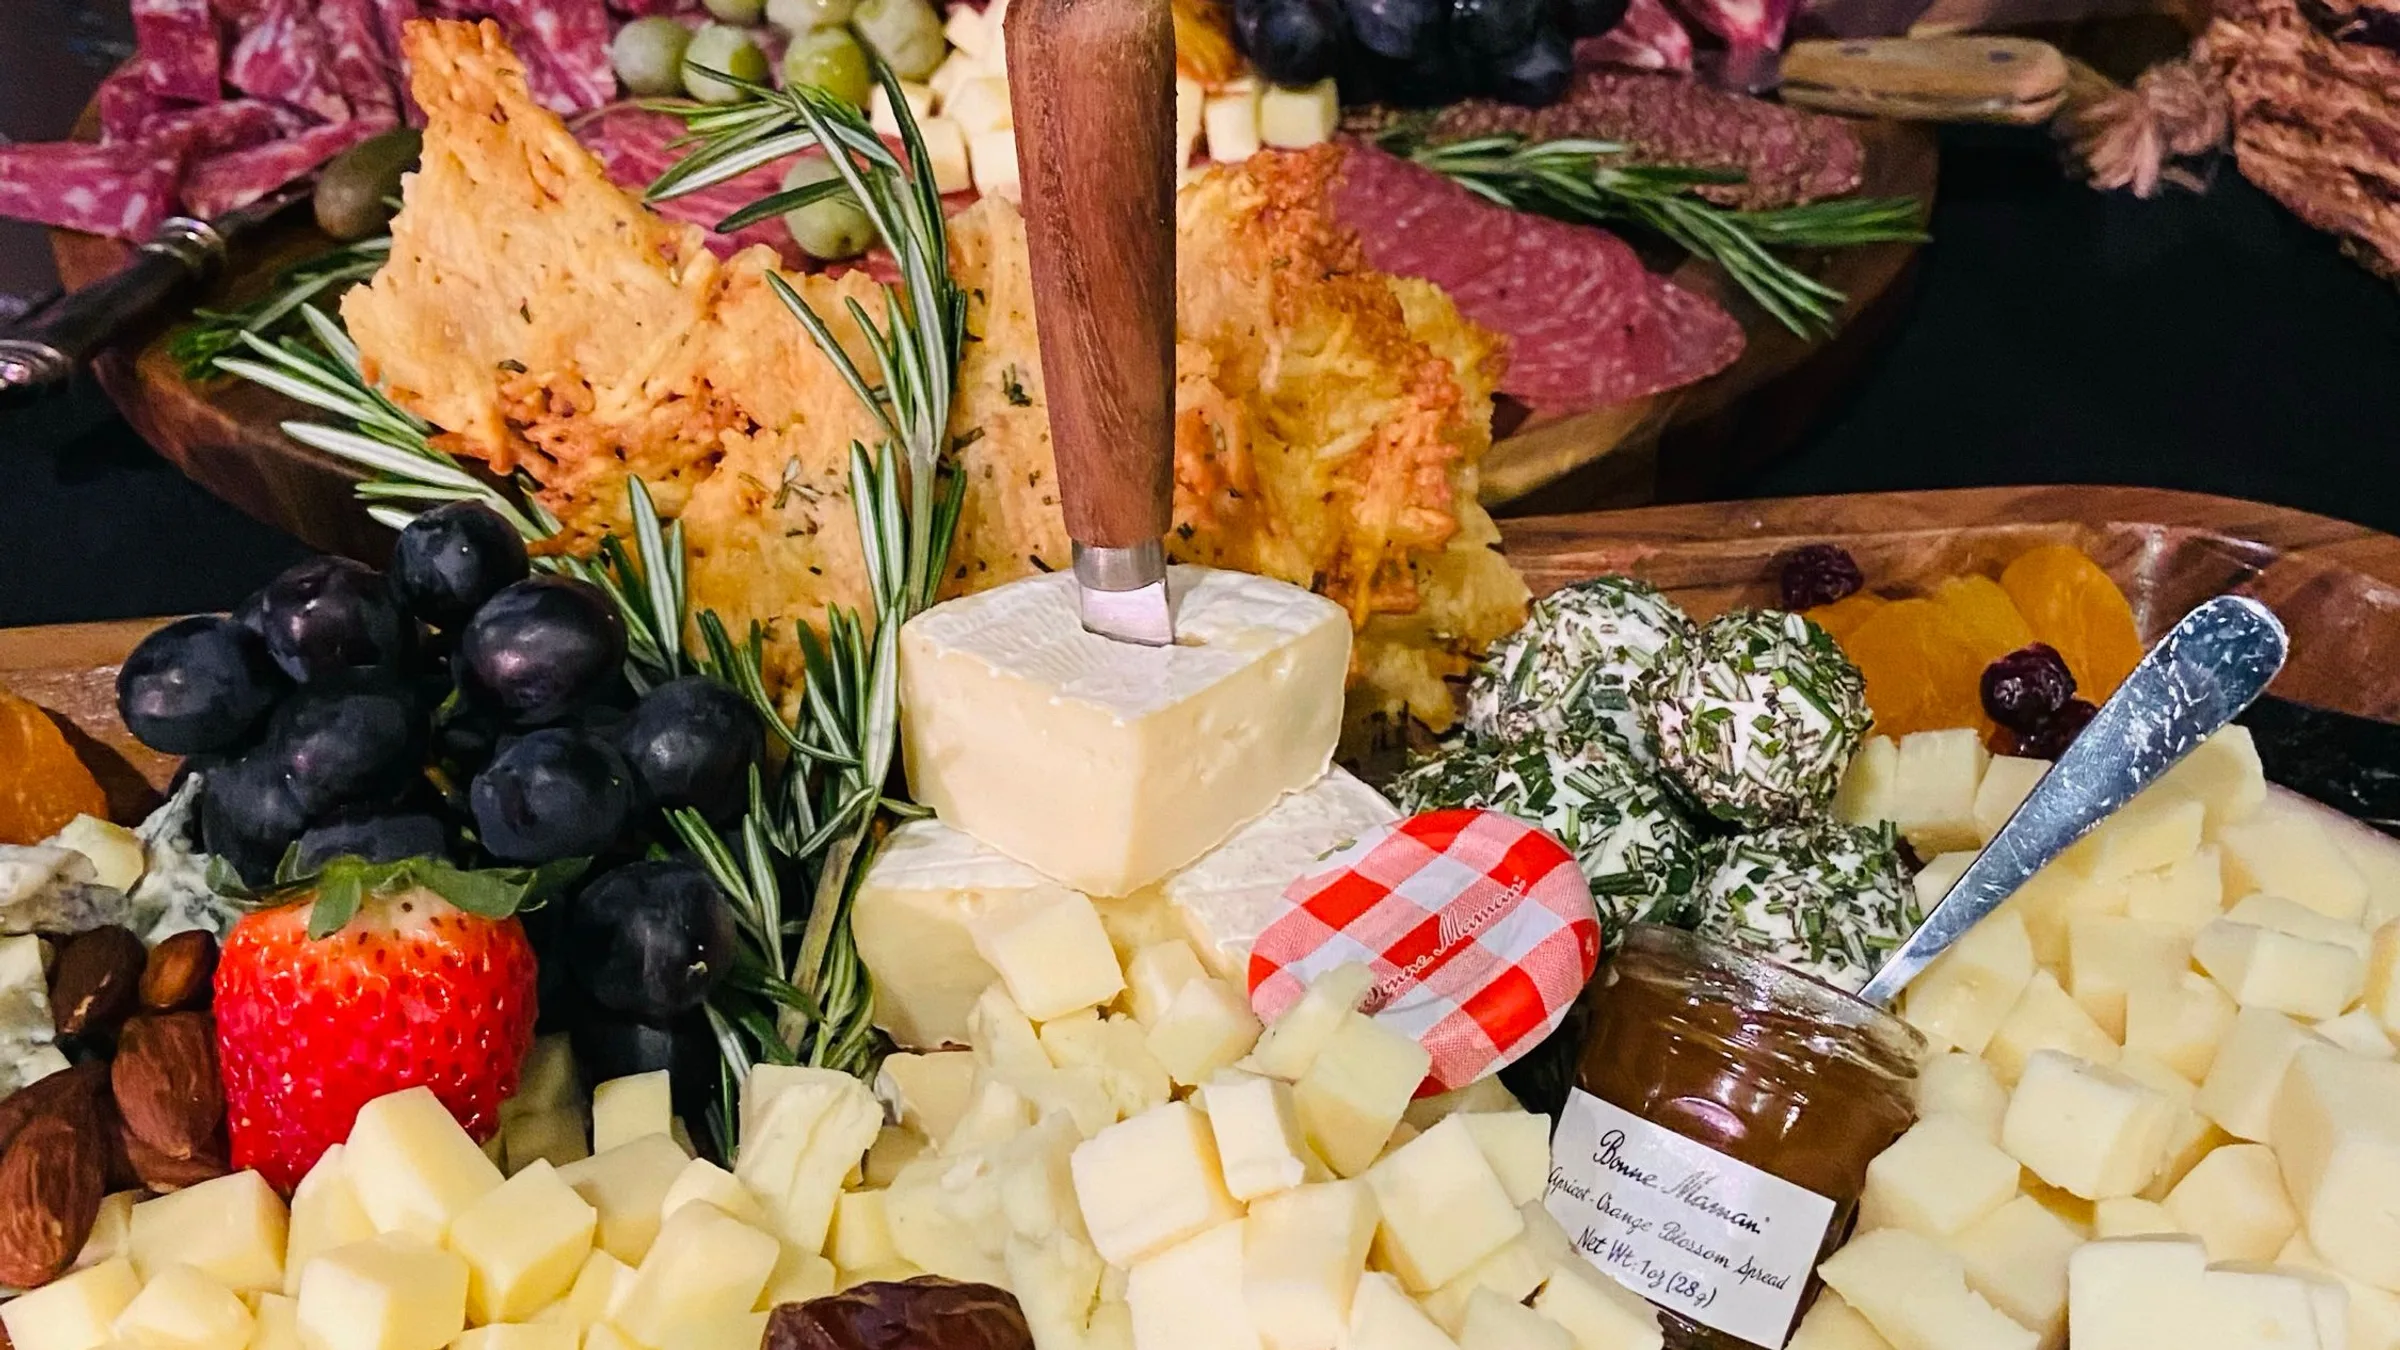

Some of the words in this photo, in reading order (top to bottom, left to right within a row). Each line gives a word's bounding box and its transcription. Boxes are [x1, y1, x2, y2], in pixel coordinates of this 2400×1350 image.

[1433, 879, 1526, 956] Maman
[1593, 1129, 1658, 1189] Bonne
[1661, 1171, 1762, 1234] Maman
[1577, 1225, 1607, 1254] Net
[1666, 1271, 1717, 1308] (28g)
[1658, 1221, 1730, 1268] Blossom
[1733, 1255, 1791, 1290] Spread
